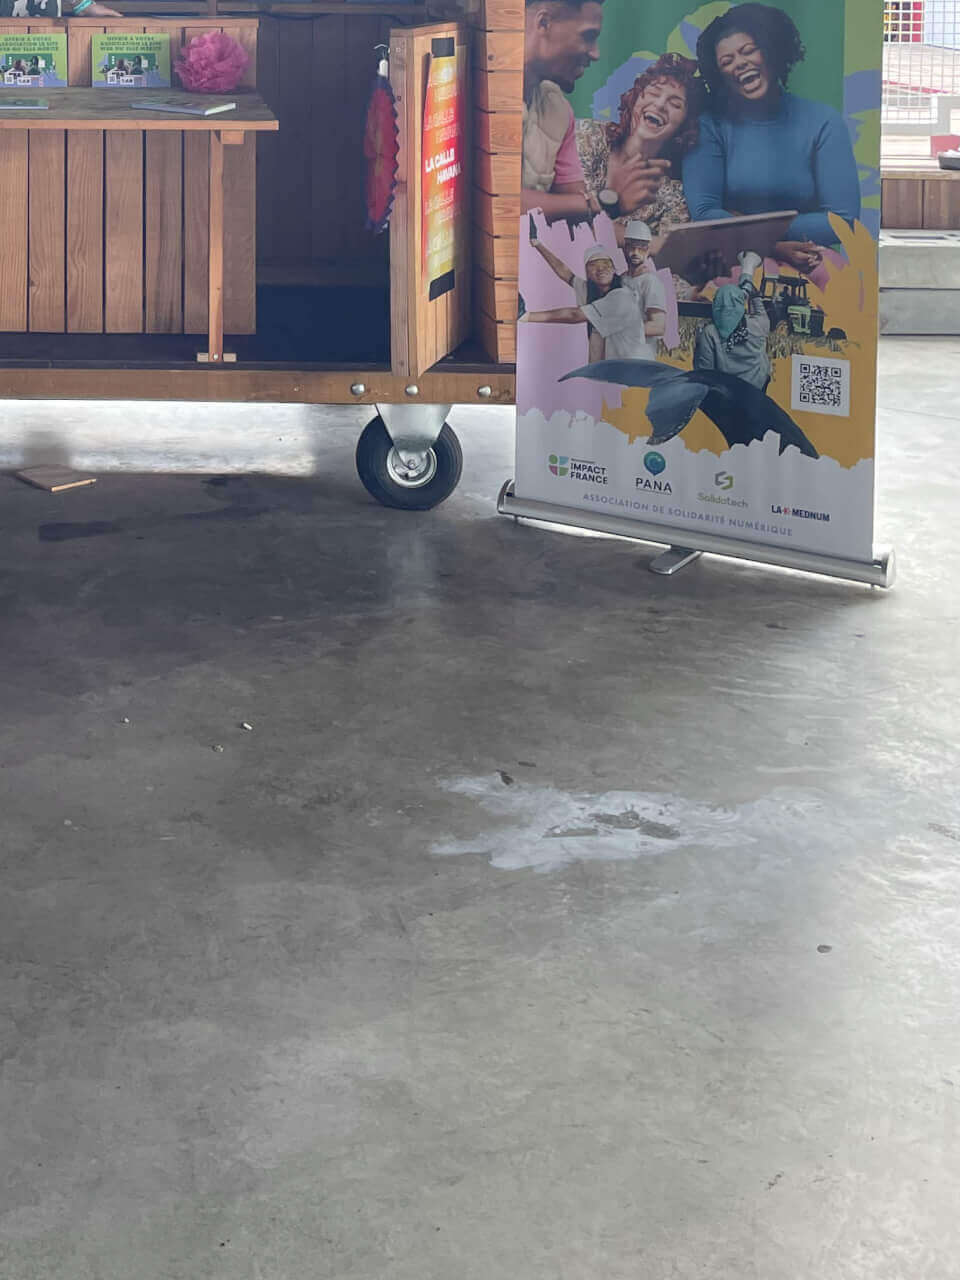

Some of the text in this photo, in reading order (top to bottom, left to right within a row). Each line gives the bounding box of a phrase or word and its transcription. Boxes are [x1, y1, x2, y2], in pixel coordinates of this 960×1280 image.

[571, 463, 607, 475] IMPACT
[570, 472, 608, 485] FRANCE
[635, 478, 672, 493] PANA
[582, 493, 649, 512] ASSOCIATION
[651, 504, 665, 515] DE
[729, 518, 793, 537] NUMÉRIQUE
[771, 505, 830, 522] LA MEDNUM
